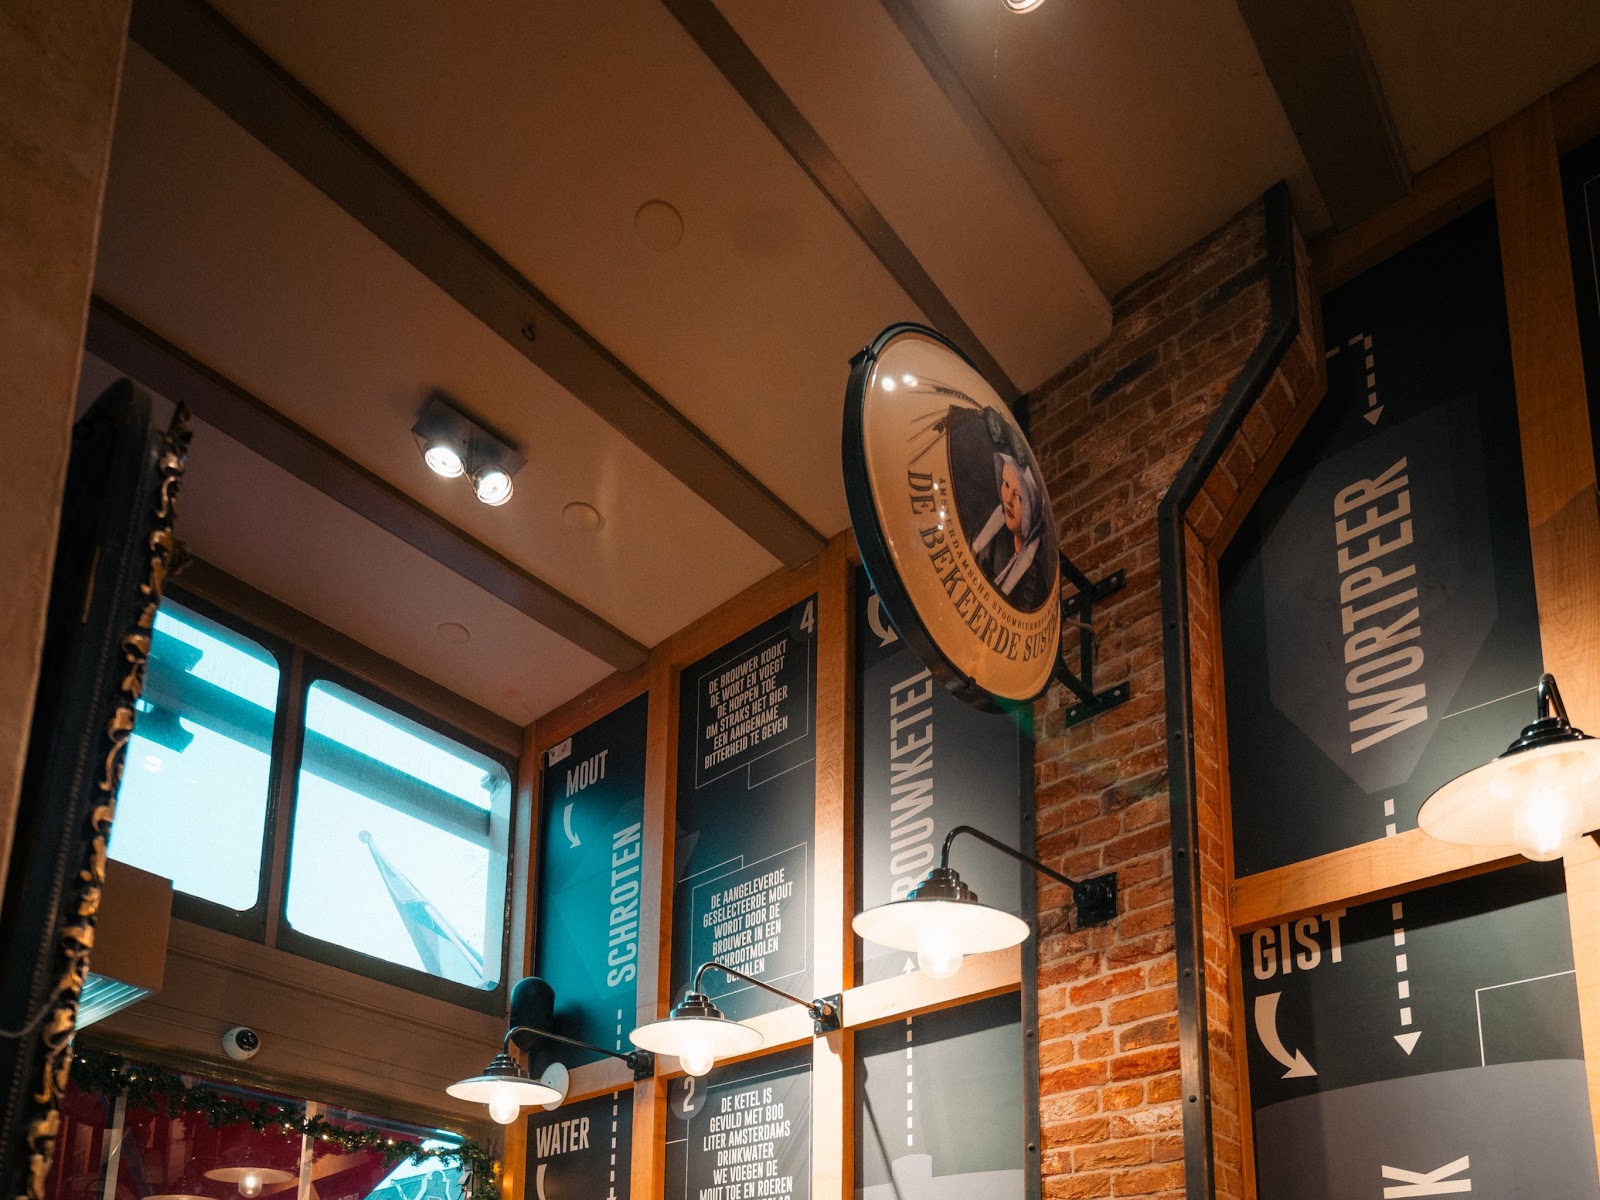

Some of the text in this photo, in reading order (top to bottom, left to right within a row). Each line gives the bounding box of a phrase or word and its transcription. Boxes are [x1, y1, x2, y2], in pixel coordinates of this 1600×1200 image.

[908, 469, 936, 515] DE
[919, 525, 1021, 661] BEKEERDE
[1334, 456, 1429, 754] WORTPEER
[800, 601, 814, 633] 4
[709, 639, 787, 695] DE BROUWER KOOKT
[711, 656, 785, 708] DE WORT EN VOEGT
[706, 685, 788, 739] OM STRAKS HET BIER
[717, 675, 776, 719] DE HOPPEN TOE
[705, 715, 788, 769] BITTERHEID TE GEVEN
[714, 705, 778, 750] EEN AANGENAME
[566, 749, 608, 798] MOUT
[890, 666, 934, 902] ROUWKETEL
[607, 822, 640, 987] SCHROTEN
[703, 882, 793, 928] GESELECTEERDE MOUT
[711, 868, 785, 910] DE AANGELEVERDE
[713, 919, 781, 956] BROUWER IN EEN
[714, 903, 780, 939] WORDT DOOR DE
[715, 936, 778, 971] SCHROOTMOLEN
[1252, 908, 1346, 981] GIST
[683, 1076, 695, 1112] 2
[721, 1087, 772, 1114] DE KETEL IS
[536, 1116, 589, 1159] WATER
[704, 1120, 790, 1151] LITER AMSTERDAMS
[710, 1103, 784, 1133] GEVULD MET 800
[713, 1160, 778, 1185] WE VOEGEN DE
[718, 1142, 773, 1166] DRINKWATER
[726, 1185, 741, 1200] TOE
[744, 1182, 755, 1198] EN
[758, 1176, 792, 1196] ROEREN
